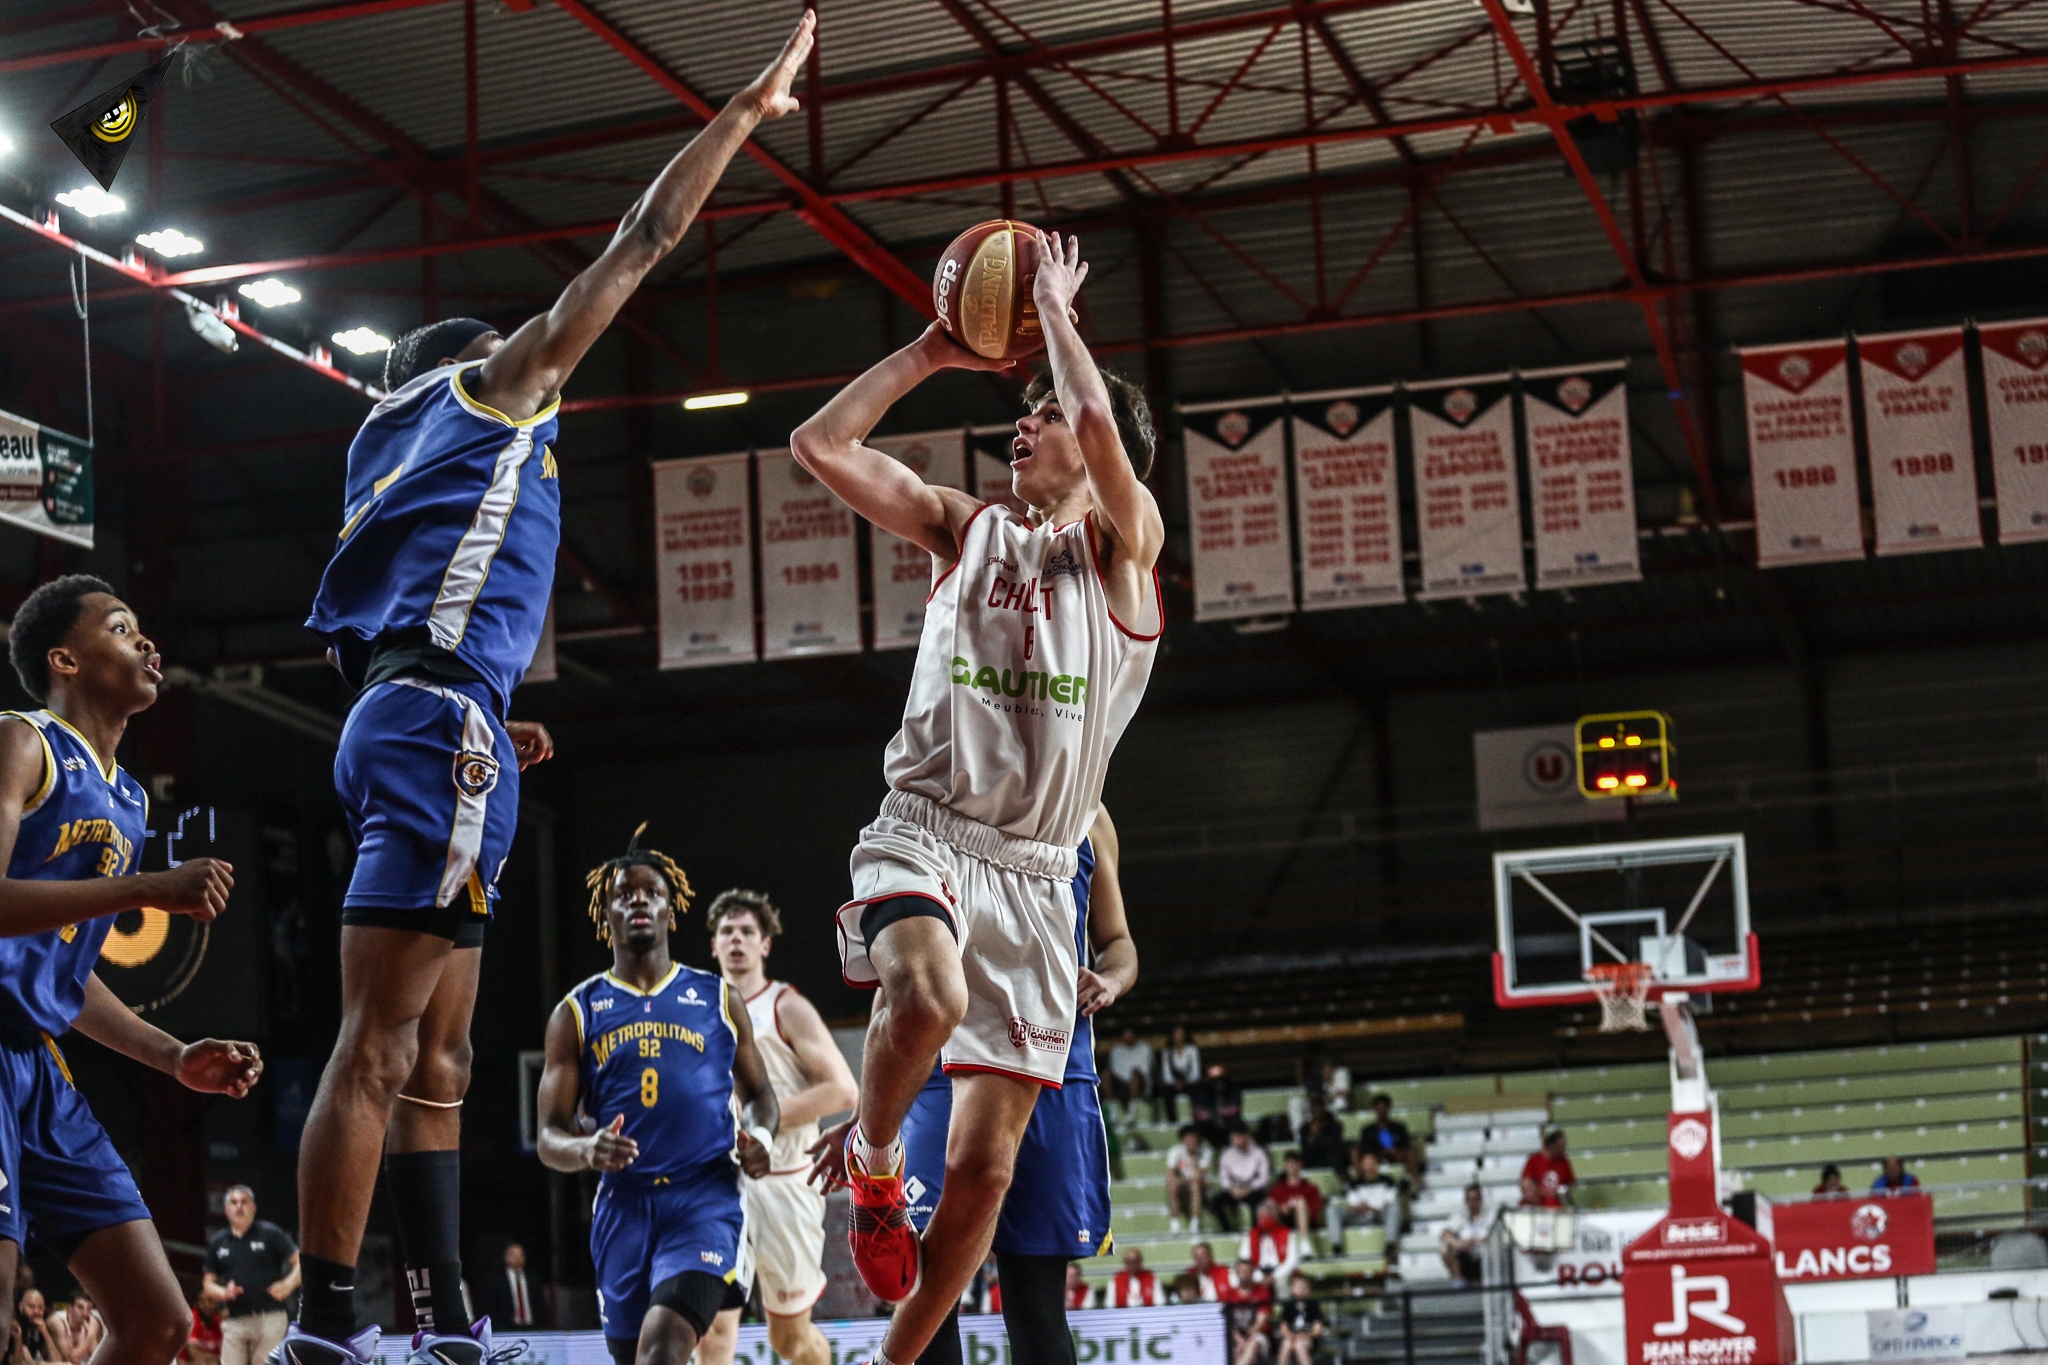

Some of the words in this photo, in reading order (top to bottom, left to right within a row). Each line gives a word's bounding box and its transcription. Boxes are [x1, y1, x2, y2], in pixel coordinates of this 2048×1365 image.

[934, 258, 957, 331] Jeep
[978, 257, 1007, 348] SPALDING
[1877, 387, 1929, 402] COUPE
[1754, 397, 1841, 414] CHAMPION
[1884, 400, 1950, 415] FRANCE
[1777, 411, 1841, 426] FRANCE
[1556, 434, 1620, 449] FRANCE
[1323, 457, 1386, 471] FRANCE
[2014, 444, 2048, 465] 19
[1214, 466, 1277, 483] FRANCE
[591, 1021, 705, 1072] METROPOLITANS
[639, 1038, 661, 1058] 92
[641, 1067, 659, 1108] 8
[1667, 1221, 1721, 1242] Betclic
[1642, 1341, 1686, 1362] JEAN
[1688, 1335, 1757, 1357] ROUYER
